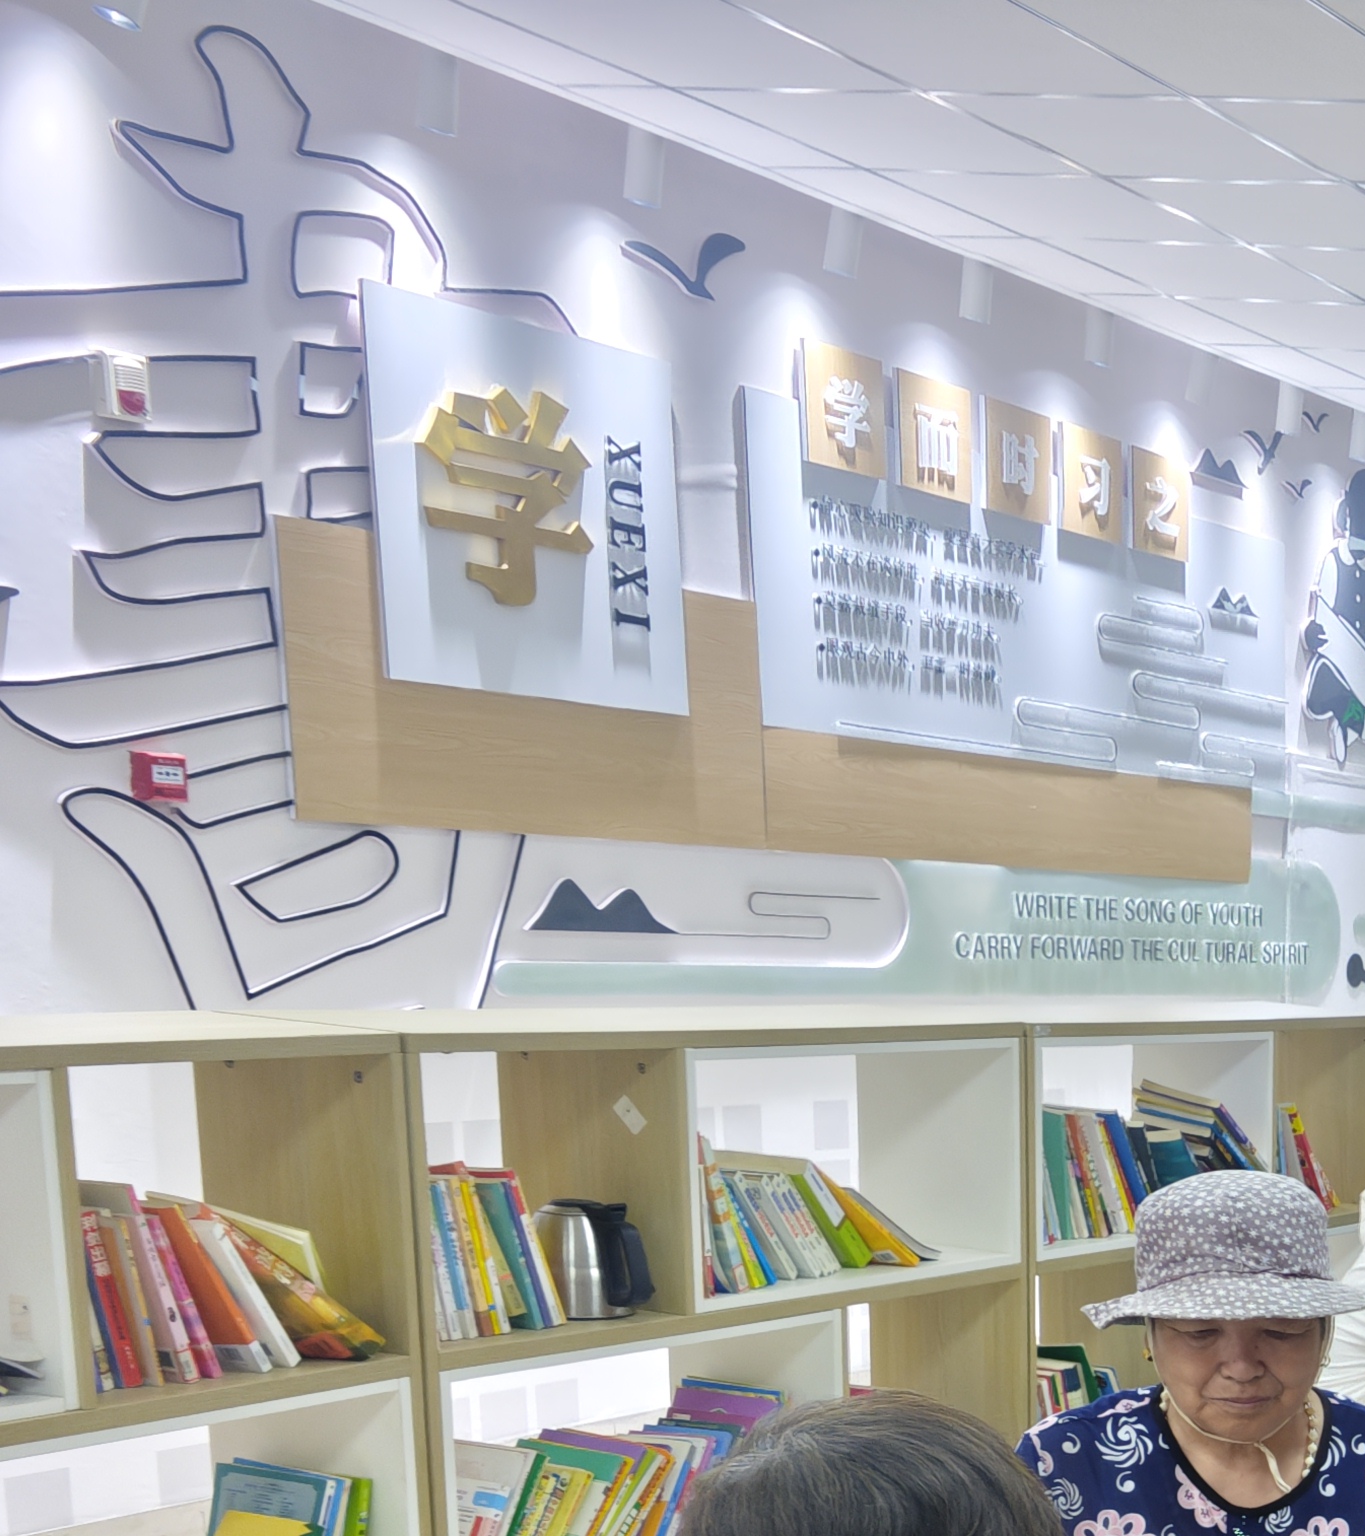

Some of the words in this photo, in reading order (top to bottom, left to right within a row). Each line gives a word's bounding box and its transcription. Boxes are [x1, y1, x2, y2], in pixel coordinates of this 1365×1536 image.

[414, 384, 594, 608] 学
[605, 436, 651, 633] XUEXI
[824, 376, 1181, 538] 学而时习之
[955, 932, 1023, 960] CARRY
[1030, 935, 1124, 962] FORWARD
[1131, 938, 1164, 963] THE
[1262, 941, 1310, 967] SPIRIT
[1014, 892, 1077, 920] WRITE
[1083, 896, 1119, 921] THE
[1124, 897, 1176, 924] SONG
[1180, 900, 1204, 925] OF
[1208, 901, 1264, 928] YOUTH
